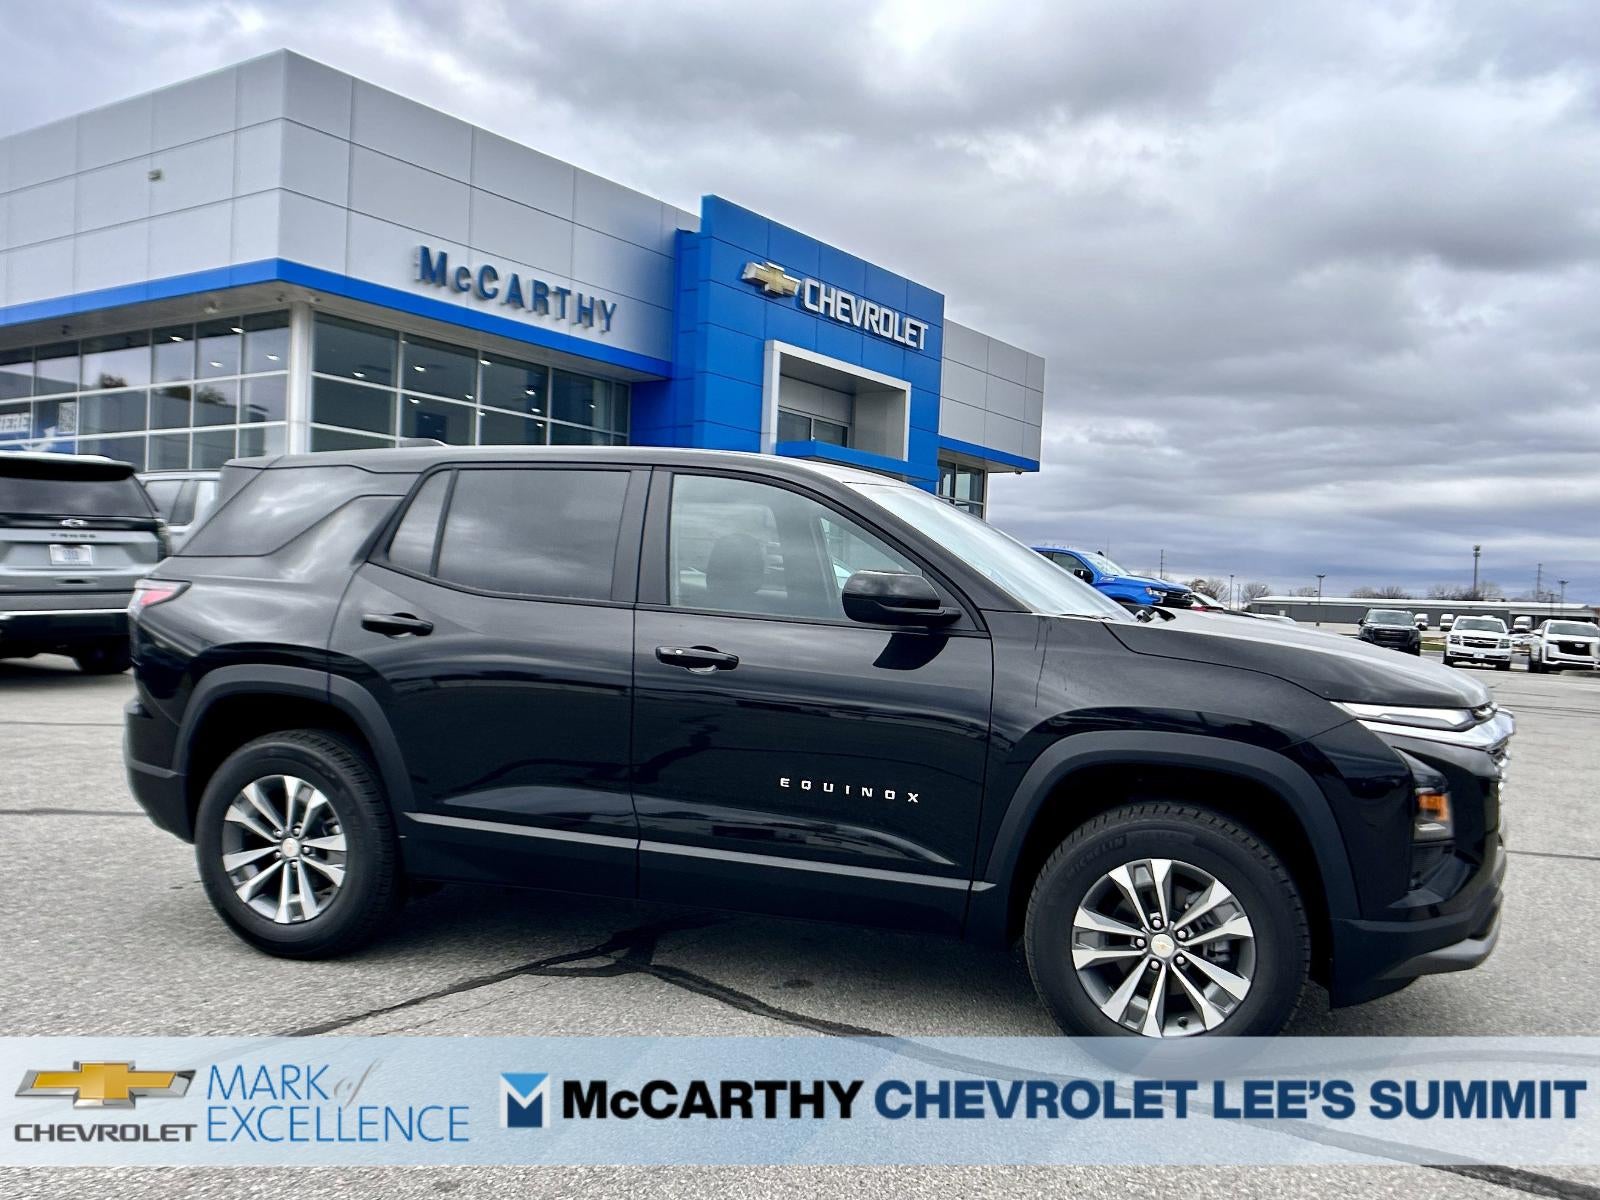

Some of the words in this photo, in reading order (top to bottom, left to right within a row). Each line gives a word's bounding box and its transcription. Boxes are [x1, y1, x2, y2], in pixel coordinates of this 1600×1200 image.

[417, 245, 622, 333] McCARTHY
[803, 278, 929, 350] CHEVROLET
[780, 777, 919, 803] EQUINOX
